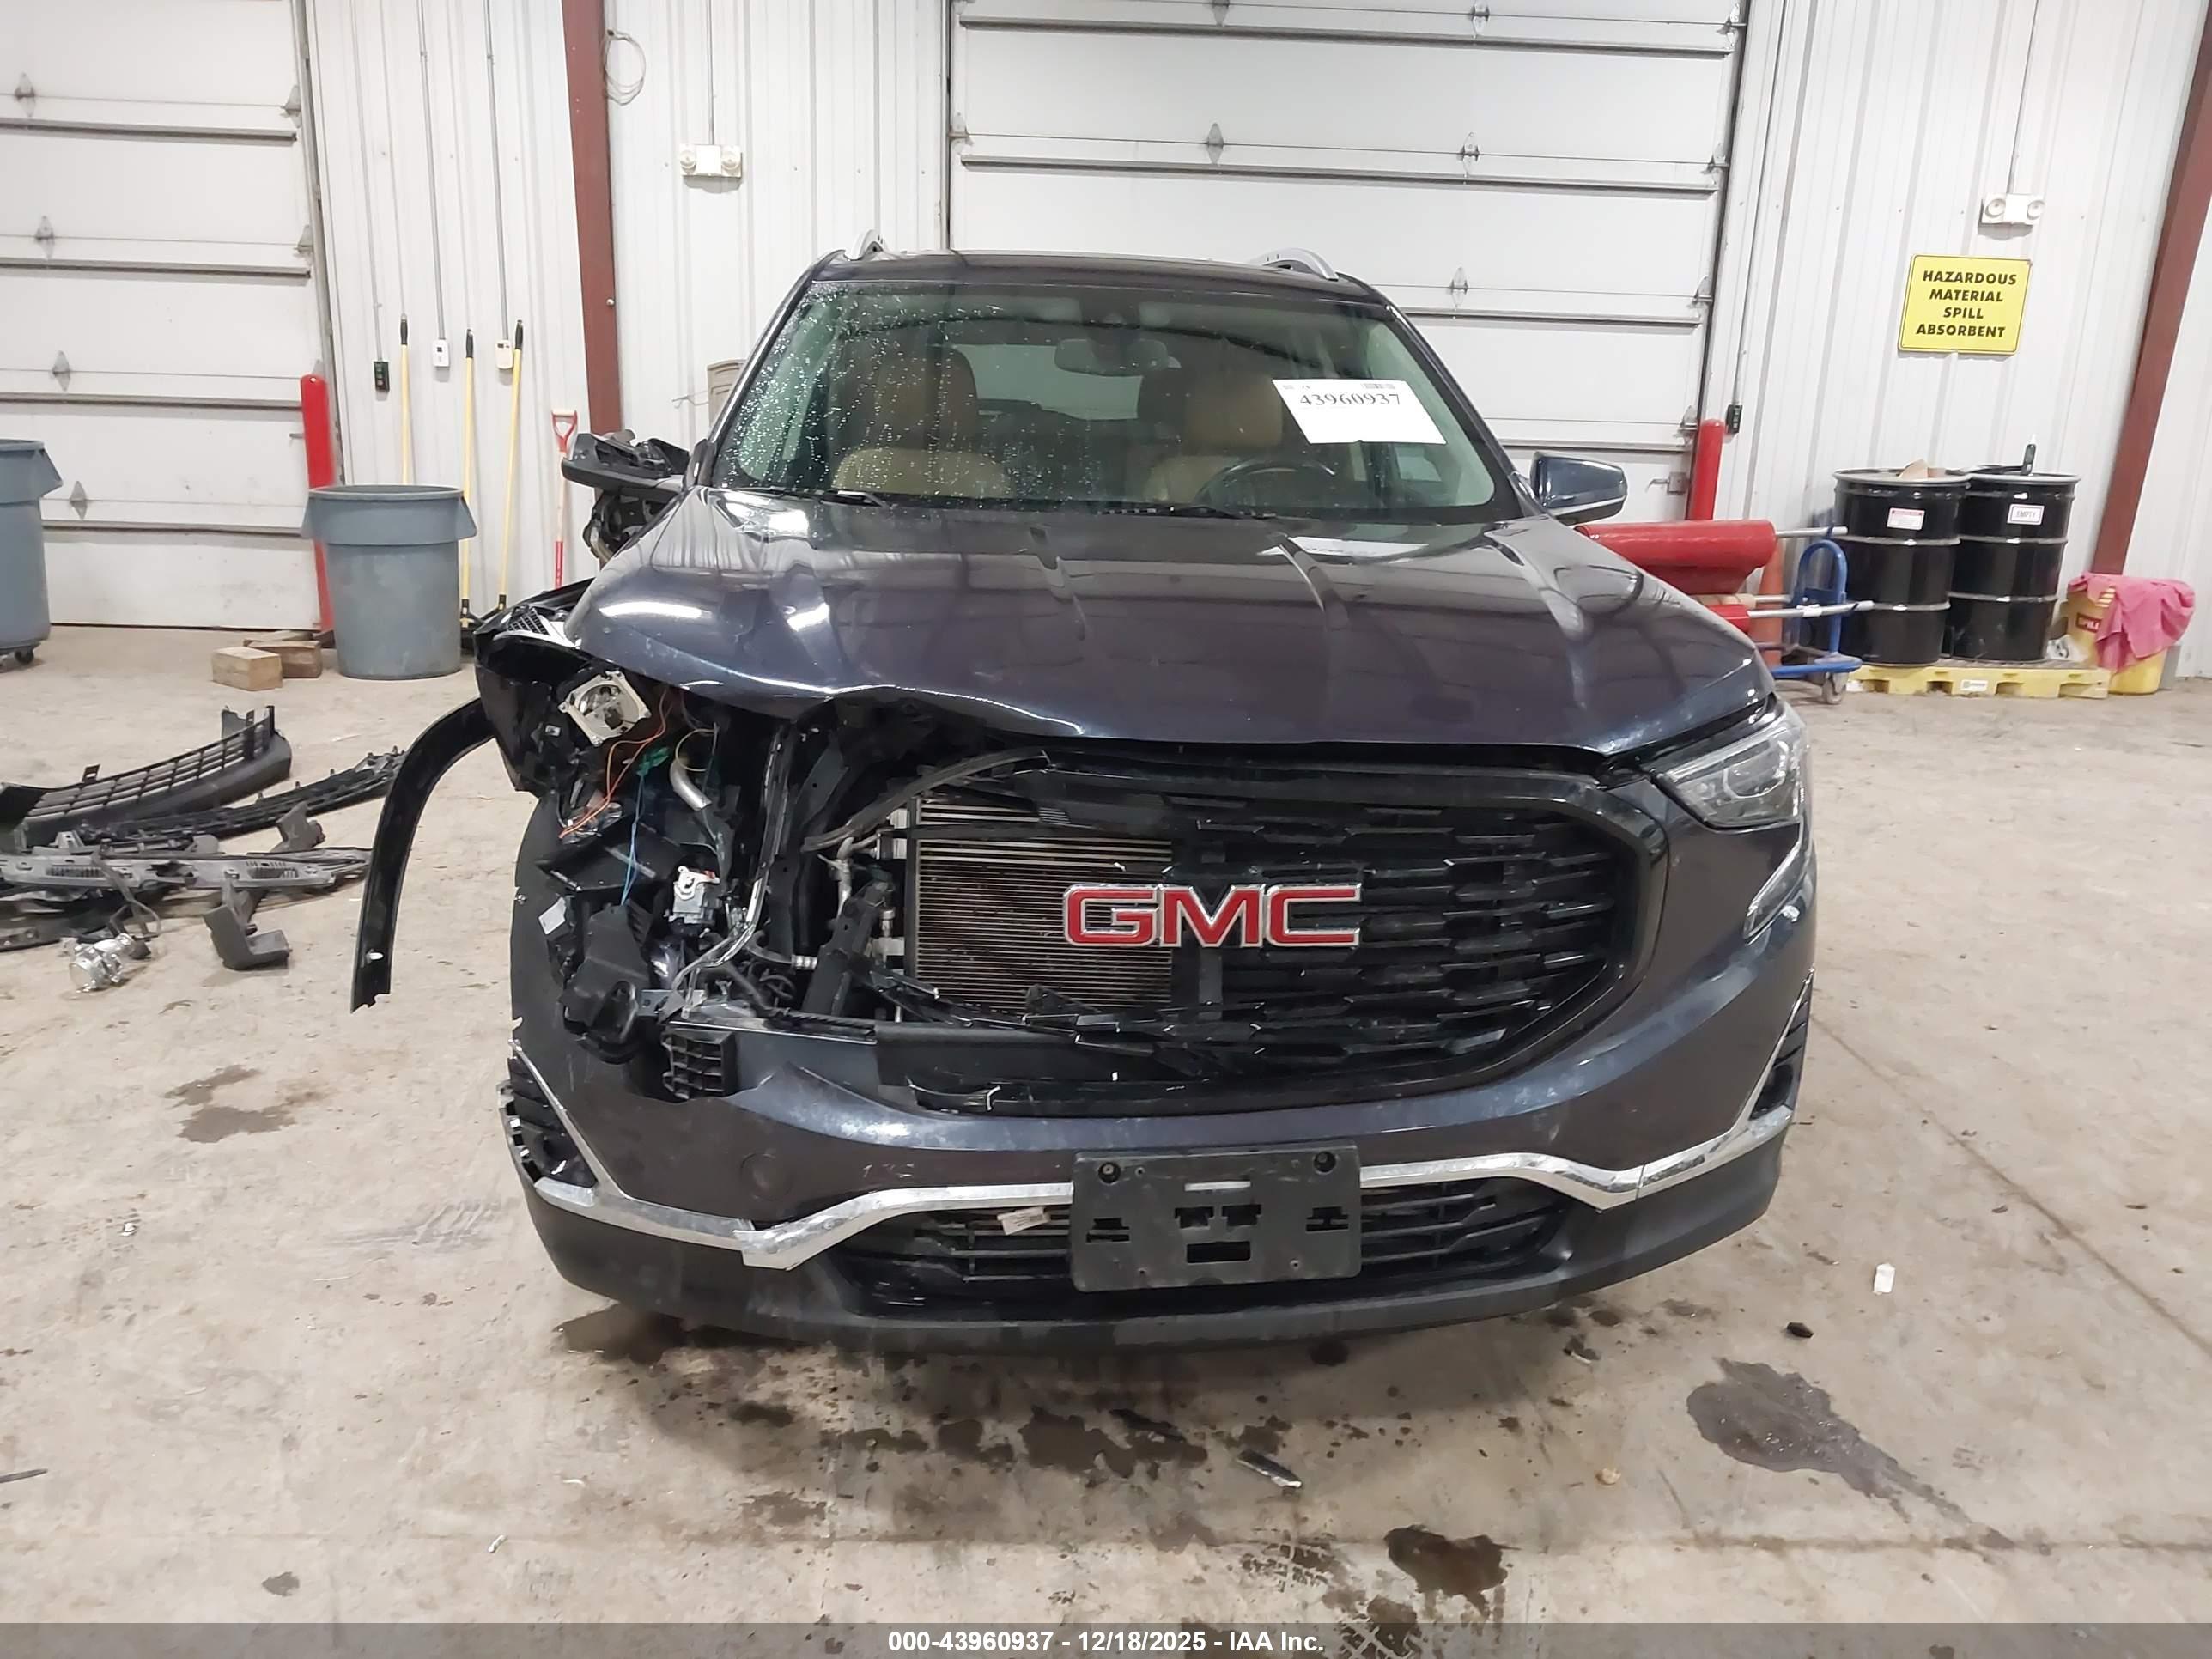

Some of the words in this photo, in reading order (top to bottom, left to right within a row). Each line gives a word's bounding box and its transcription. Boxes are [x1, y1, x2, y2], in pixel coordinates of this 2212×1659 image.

[1922, 270, 2017, 285] HAZARDOUS
[1929, 288, 2003, 302] MATERIAL
[1942, 307, 1984, 319] SPILL
[1915, 323, 2006, 337] ABSORBENT
[1299, 392, 1401, 406] 43960937
[1062, 883, 1362, 948] GMC
